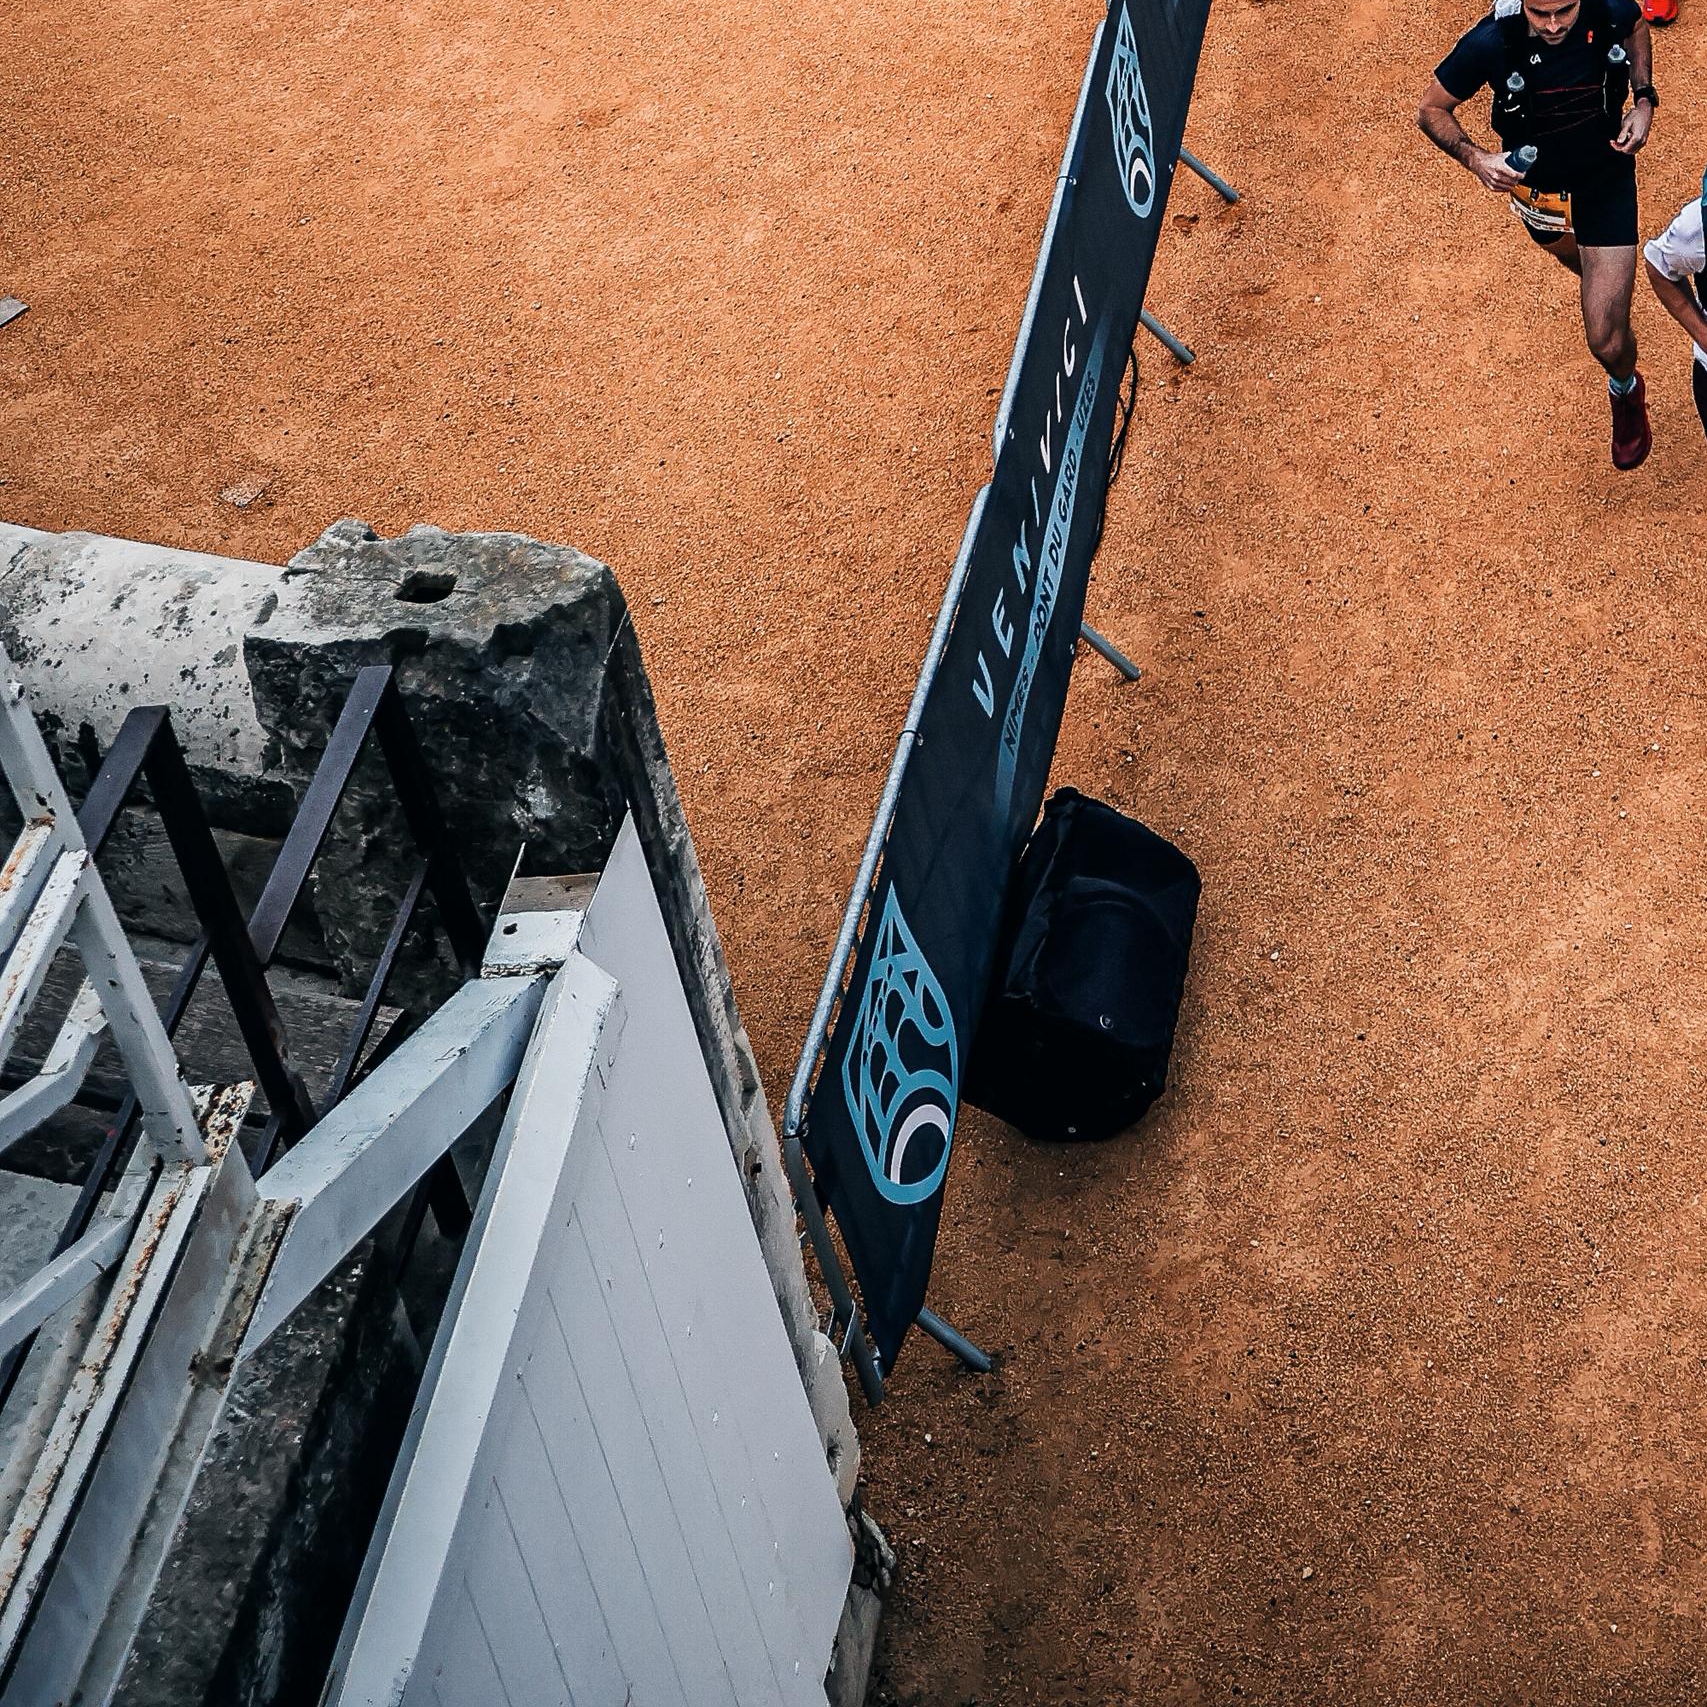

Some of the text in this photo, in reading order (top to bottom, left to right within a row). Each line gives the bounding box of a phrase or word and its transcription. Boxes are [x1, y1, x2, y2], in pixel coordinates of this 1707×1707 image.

[1033, 580, 1057, 650] PONT
[1047, 529, 1066, 571] DU
[1058, 459, 1079, 525] GARD
[1075, 371, 1096, 429] UZES
